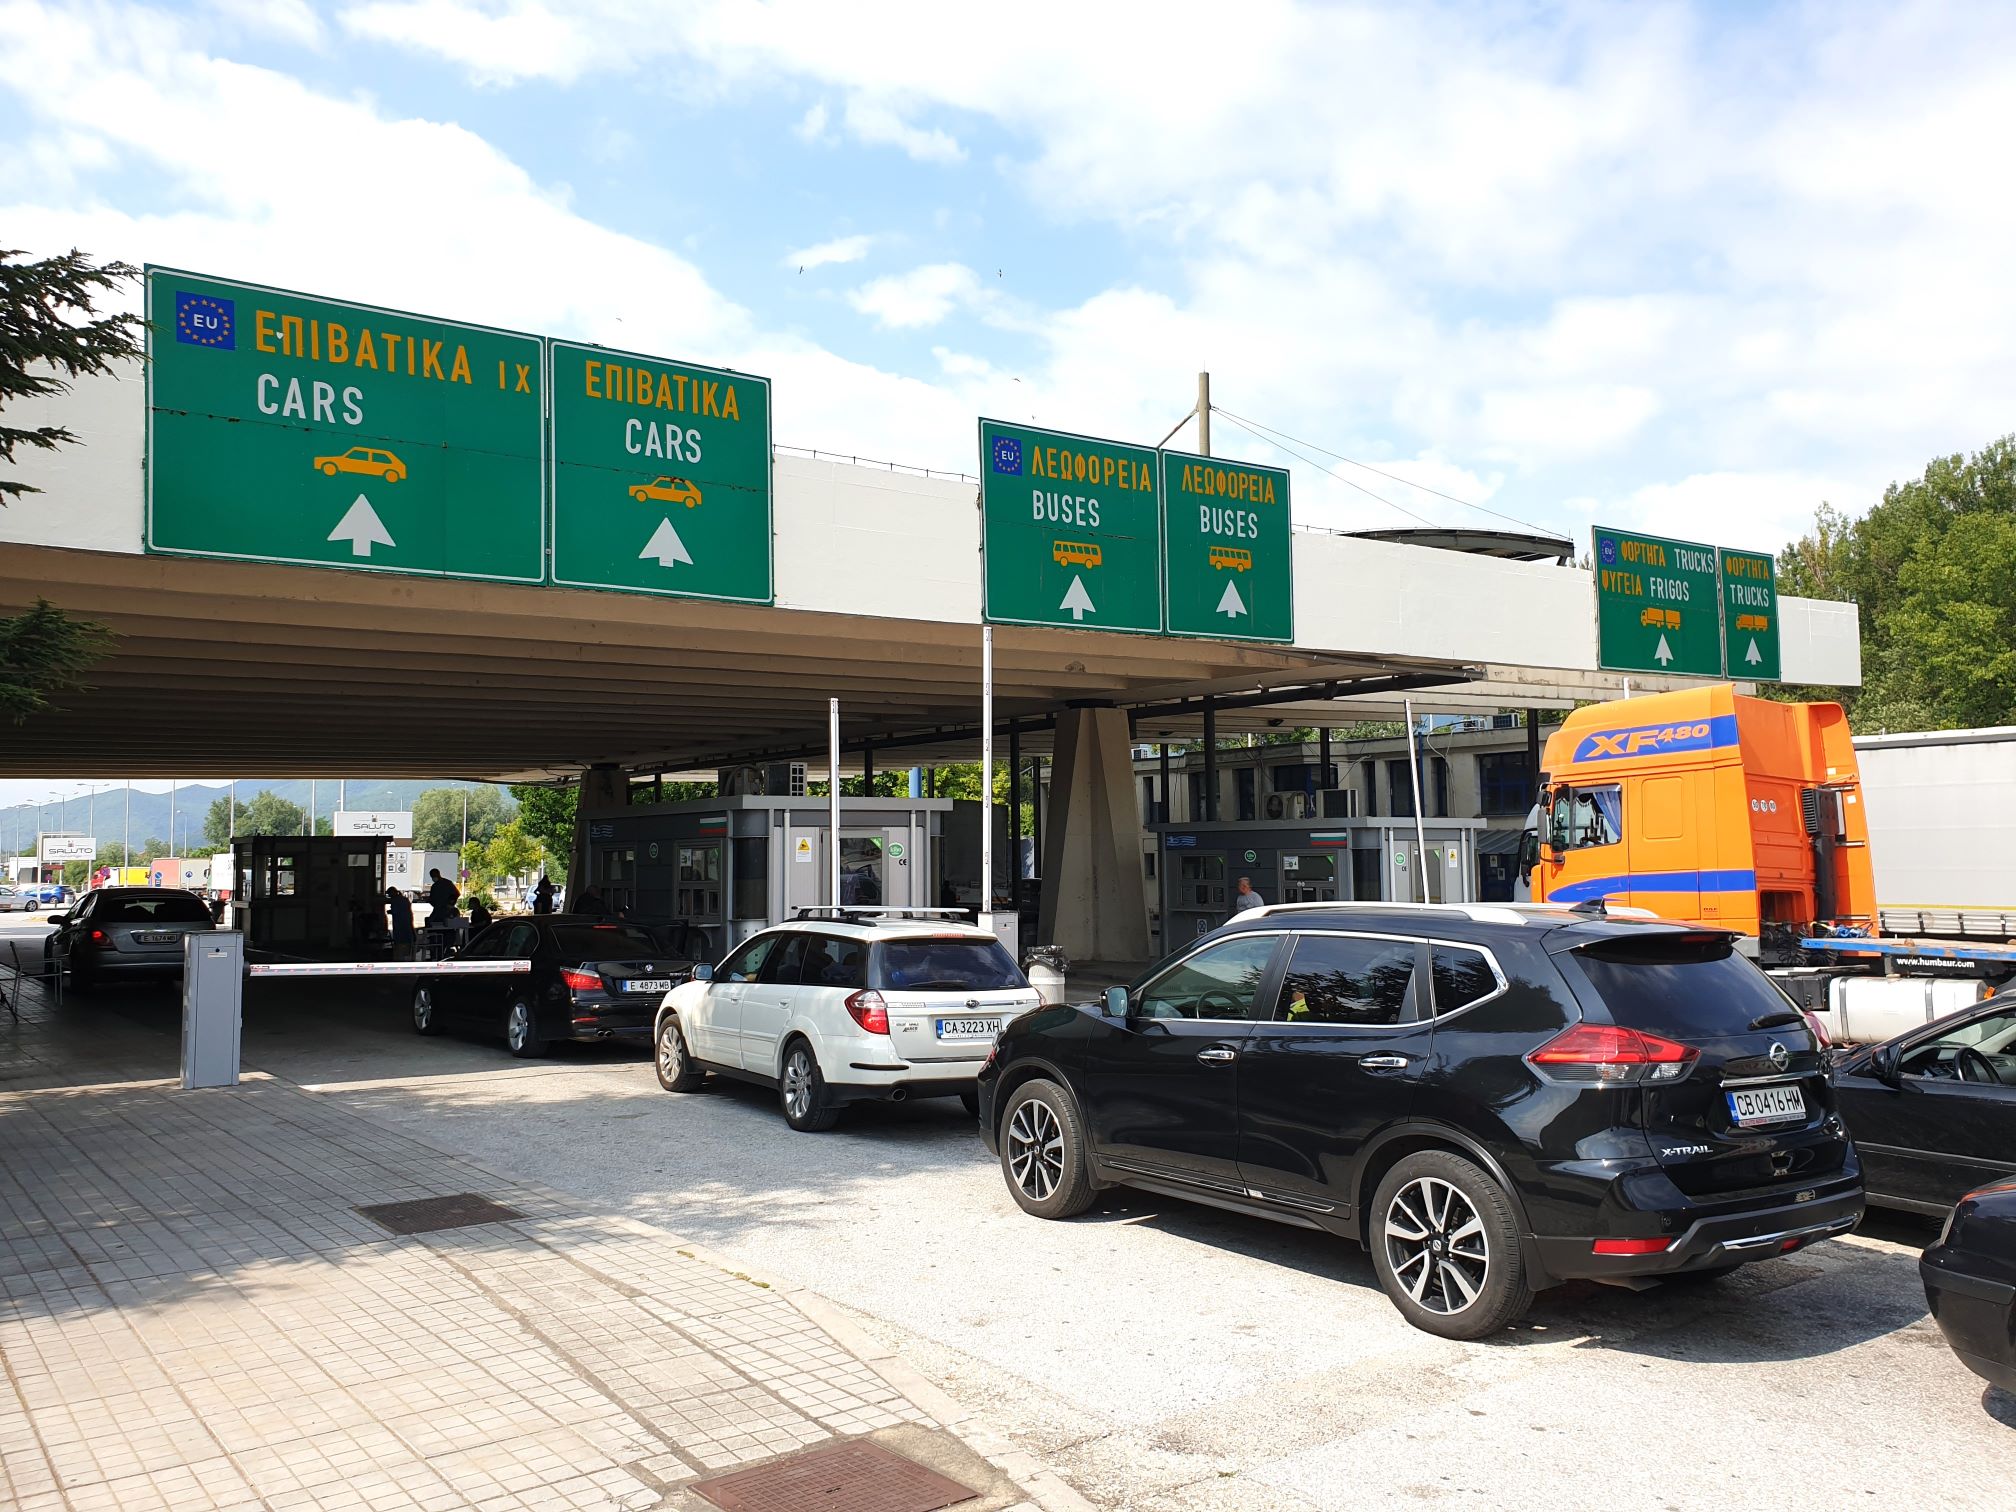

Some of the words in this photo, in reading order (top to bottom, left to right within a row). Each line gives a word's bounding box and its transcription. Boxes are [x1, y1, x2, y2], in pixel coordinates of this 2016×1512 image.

[194, 313, 218, 330] EU
[256, 310, 472, 385] ΕΠΙΒΑΤΙΚΑ
[257, 373, 364, 425] CARS
[586, 360, 740, 421] ΕΠΙΒΑΤΙΚΑ
[625, 418, 703, 464] CARS
[1001, 450, 1014, 461] EU
[1032, 446, 1152, 492] ΛΕΩΦΟΡΕΙΑ
[1182, 464, 1276, 504] ΛΕΩΦΟΡΕΙΑ
[1032, 489, 1100, 527] BUSES
[1200, 505, 1258, 539] BUSES
[1604, 547, 1612, 555] EU
[1621, 541, 1666, 567] ΦΟΡΤΗΓΑ
[1674, 548, 1715, 574] TRUCKS
[1725, 556, 1770, 580] ΦΟΡΤΗΓΑ
[1650, 577, 1690, 602] FRIGOS
[1729, 583, 1770, 607] TRUCKS
[48, 847, 93, 855] SALUTO
[899, 858, 907, 866] CE
[1896, 957, 1975, 969] www.humbaur.com
[630, 982, 636, 990] E
[639, 981, 658, 990] 4873
[659, 981, 670, 990] MB
[944, 1021, 958, 1033] CA
[960, 1020, 985, 1033] 3223
[986, 1020, 999, 1033] XH
[1736, 1094, 1755, 1116] CB
[1755, 1091, 1786, 1114] 0416
[1784, 1089, 1803, 1111] HM
[1660, 1145, 1714, 1157] X-TRAIL
